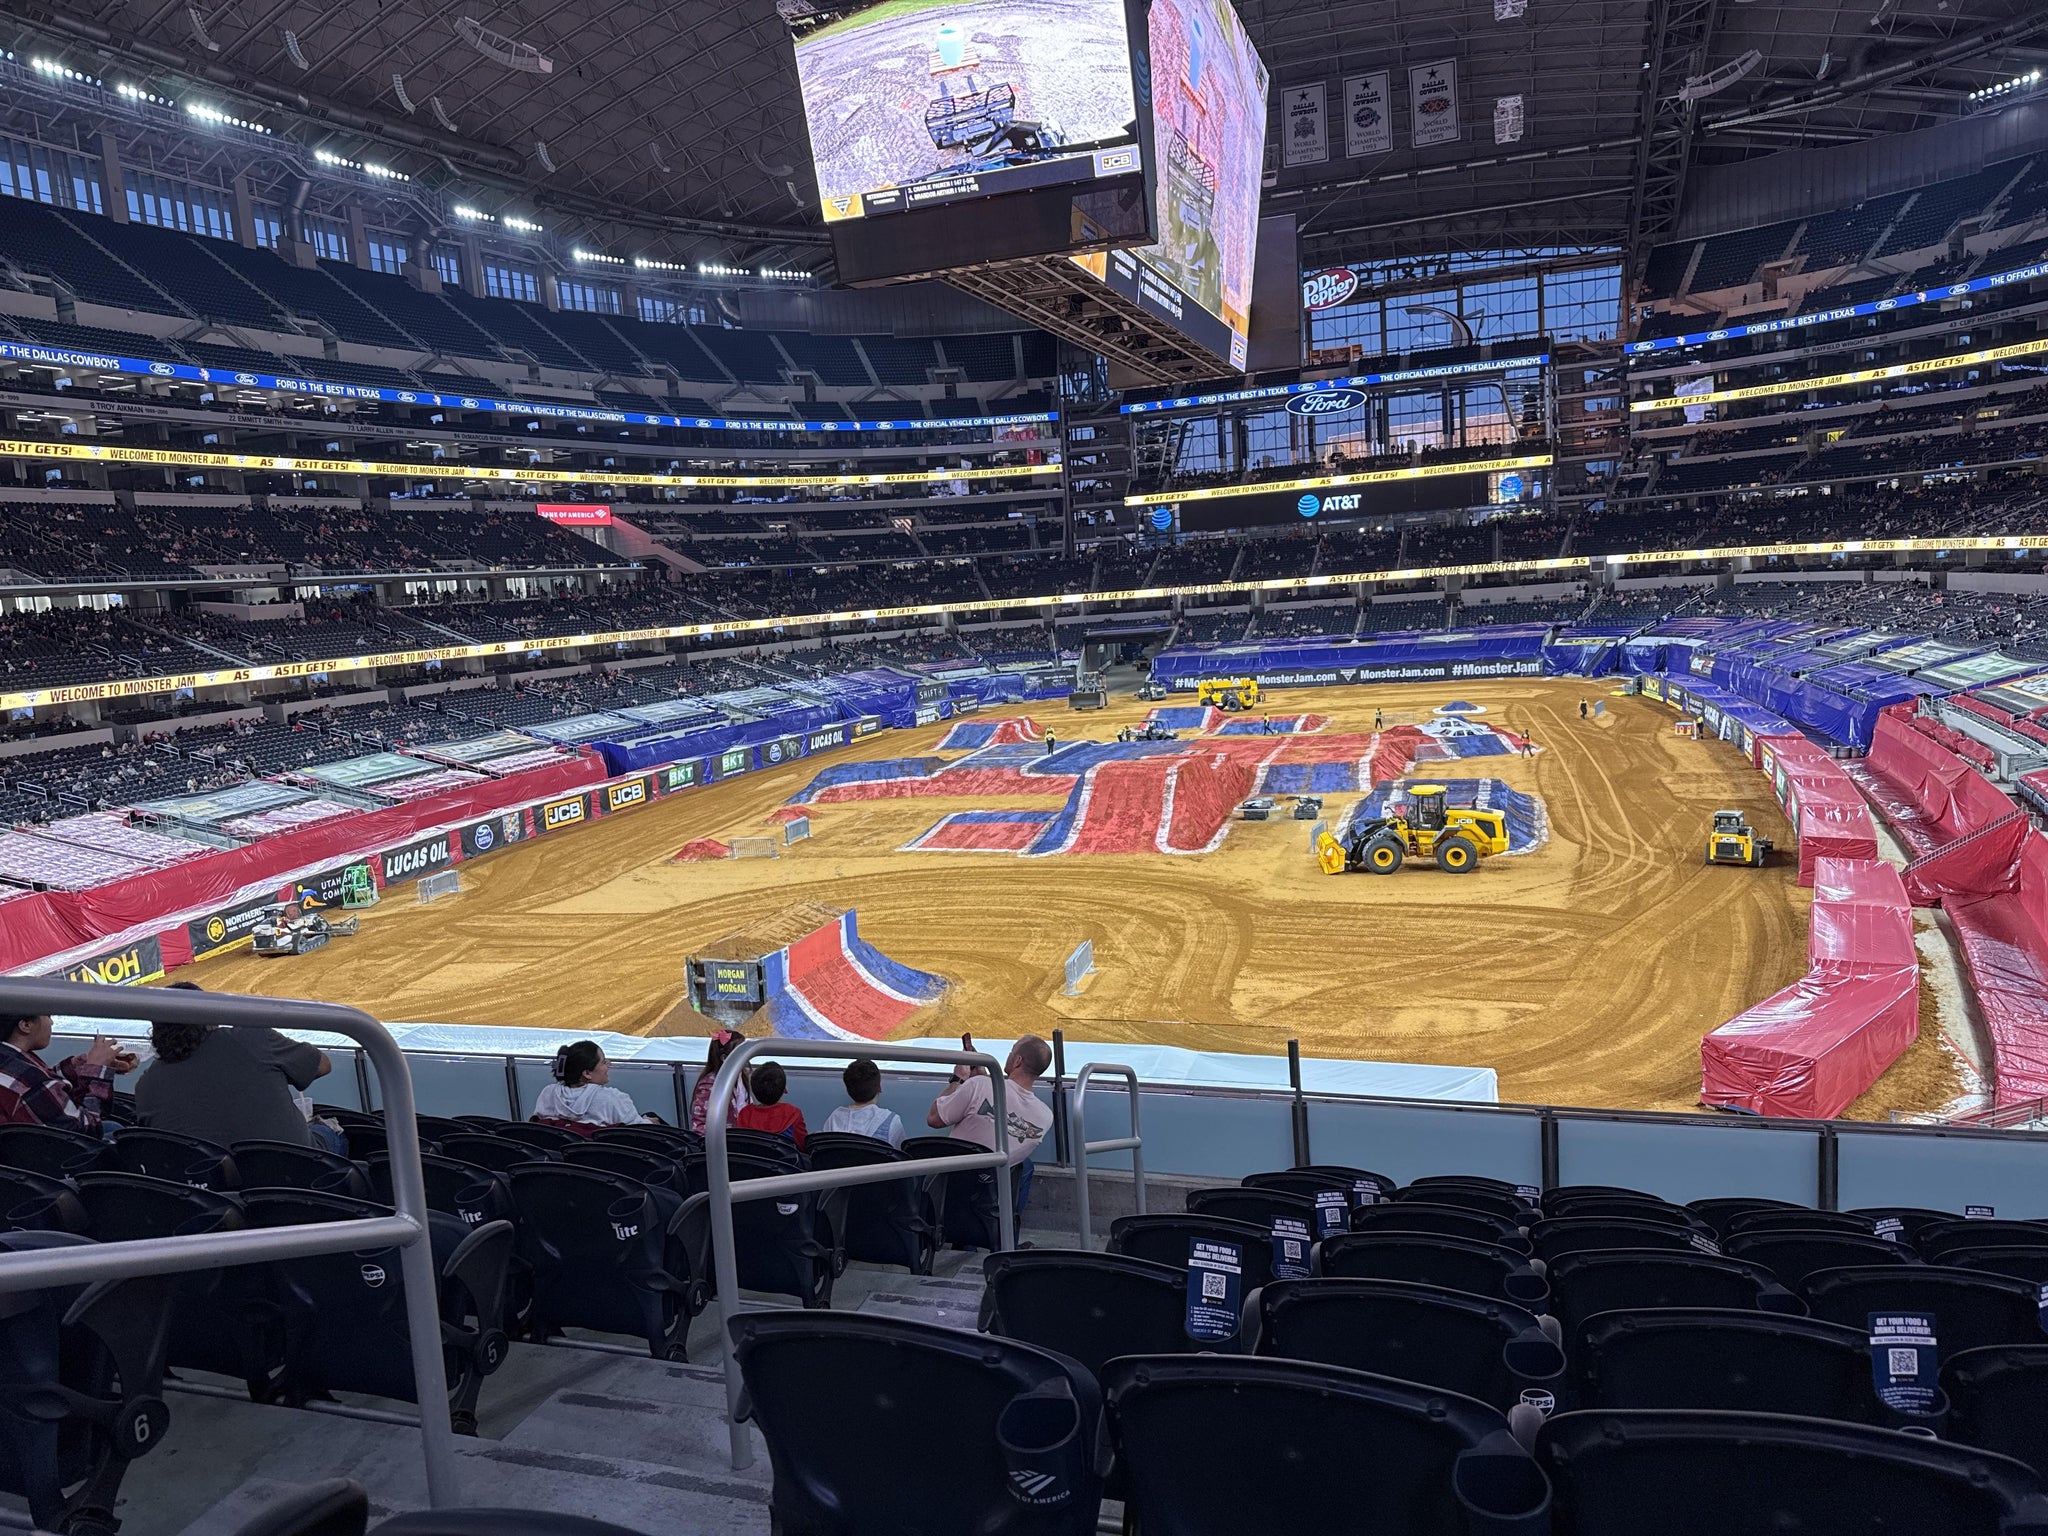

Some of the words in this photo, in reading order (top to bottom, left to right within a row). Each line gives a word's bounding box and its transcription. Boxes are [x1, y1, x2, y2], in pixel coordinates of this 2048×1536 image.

[1420, 85, 1448, 96] COWBOYS
[1422, 79, 1445, 88] DALLAS
[1353, 97, 1381, 106] COWBOYS
[1355, 91, 1378, 99] DALLAS
[1291, 107, 1318, 117] COWBOYS
[1293, 102, 1315, 110] DALLAS
[1423, 118, 1448, 127] WORLD
[1357, 129, 1381, 138] WORLD
[1415, 125, 1456, 137] CHAMPIONS
[1294, 139, 1317, 148] WORLD
[1350, 135, 1388, 146] CHAMPIONS
[1287, 146, 1324, 156] CHAMPIONS
[1104, 155, 1130, 167] JCB
[1317, 273, 1339, 291] Dr
[1990, 274, 2005, 286] THE
[2006, 266, 2038, 283] OFFICIAL
[1304, 277, 1353, 308] Pepper
[1746, 323, 1768, 334] FORD
[1770, 322, 1777, 331] IS
[1779, 318, 1795, 329] THE
[1797, 314, 1816, 326] BEST
[1819, 313, 1827, 321] IN
[1829, 307, 1854, 320] TEXAS
[10, 346, 31, 358] THE
[32, 349, 69, 363] DALLAS
[70, 354, 119, 369] COWBOYS
[1379, 373, 1393, 382] THE
[1393, 370, 1424, 381] OFFICIAL
[1423, 366, 1452, 377] VEHICLE
[1452, 365, 1462, 374] OF
[1463, 363, 1478, 372] THE
[1478, 361, 1505, 371] DALLAS
[1504, 356, 1540, 367] COWBOYS
[1872, 369, 1886, 377] AS
[1906, 363, 1921, 372] AS
[1922, 361, 1933, 369] IT
[1934, 356, 1964, 367] GETS!
[276, 379, 297, 389] FORD
[299, 381, 307, 391] IS
[308, 382, 323, 392] THE
[326, 384, 344, 395] BEST
[346, 387, 354, 396] IN
[356, 388, 380, 399] TEXAS
[1738, 386, 1774, 397] WELCOME
[1788, 379, 1824, 390] MONSTER
[1825, 376, 1842, 384] JAM
[1198, 395, 1216, 405] FORD
[1217, 394, 1224, 402] IS
[1225, 392, 1239, 401] THE
[1239, 390, 1256, 399] BEST
[1257, 389, 1265, 397] IN
[1266, 386, 1288, 396] TEXAS
[1301, 393, 1351, 412] Ford
[97, 403, 115, 411] TROY
[117, 404, 143, 413] AIKMAN
[494, 402, 506, 411] THE
[507, 404, 531, 413] OFFICIAL
[532, 406, 553, 415] VEHICLE
[555, 408, 565, 416] OF
[566, 409, 577, 417] THE
[577, 410, 598, 419] DALLAS
[598, 412, 625, 421] COWBOYS
[238, 416, 261, 424] EMMITT
[18, 443, 32, 453] IT
[34, 444, 72, 455] GETS!
[110, 449, 153, 460] WELCOME
[155, 452, 166, 461] TO
[168, 453, 208, 463] MONSTER
[210, 455, 228, 464] JAM
[260, 458, 273, 466] AS
[294, 460, 307, 468] AS
[308, 461, 322, 469] IT
[324, 462, 348, 470] GETS!
[1322, 494, 1362, 511] AT&T
[233, 670, 249, 680] AS
[274, 666, 288, 676] AS
[291, 664, 303, 674] IT
[306, 660, 336, 672] GETS!
[1360, 667, 1445, 680] MonsterJam.com
[1452, 662, 1539, 676] #MonsterJam
[1257, 672, 1337, 685] MonsterJam.com
[50, 685, 104, 702] WELCOME
[107, 683, 120, 696] TO
[124, 678, 171, 693] MONSTER
[174, 675, 195, 688] JAM
[811, 735, 832, 750] LUCAS
[832, 731, 843, 744] OIL
[722, 753, 744, 770] BKT
[669, 766, 693, 784] BKT
[613, 785, 643, 804] JCB
[549, 802, 581, 824] JCB
[386, 845, 427, 878] LUCAS
[430, 840, 448, 861] OIL
[321, 877, 342, 889] UTAH
[718, 969, 745, 979] MORGAN
[719, 984, 746, 993] MORGAN
[1206, 1244, 1218, 1252] YOUR
[1219, 1246, 1231, 1255] FOOD
[1194, 1250, 1211, 1259] DRINKS
[1212, 1254, 1237, 1264] DELIVERED!
[1875, 1326, 1895, 1334] DRINKS
[488, 1341, 497, 1363] 5
[1522, 1398, 1552, 1406] PEPSI
[134, 1414, 150, 1443] 6
[1034, 1490, 1070, 1504] AMERICA
